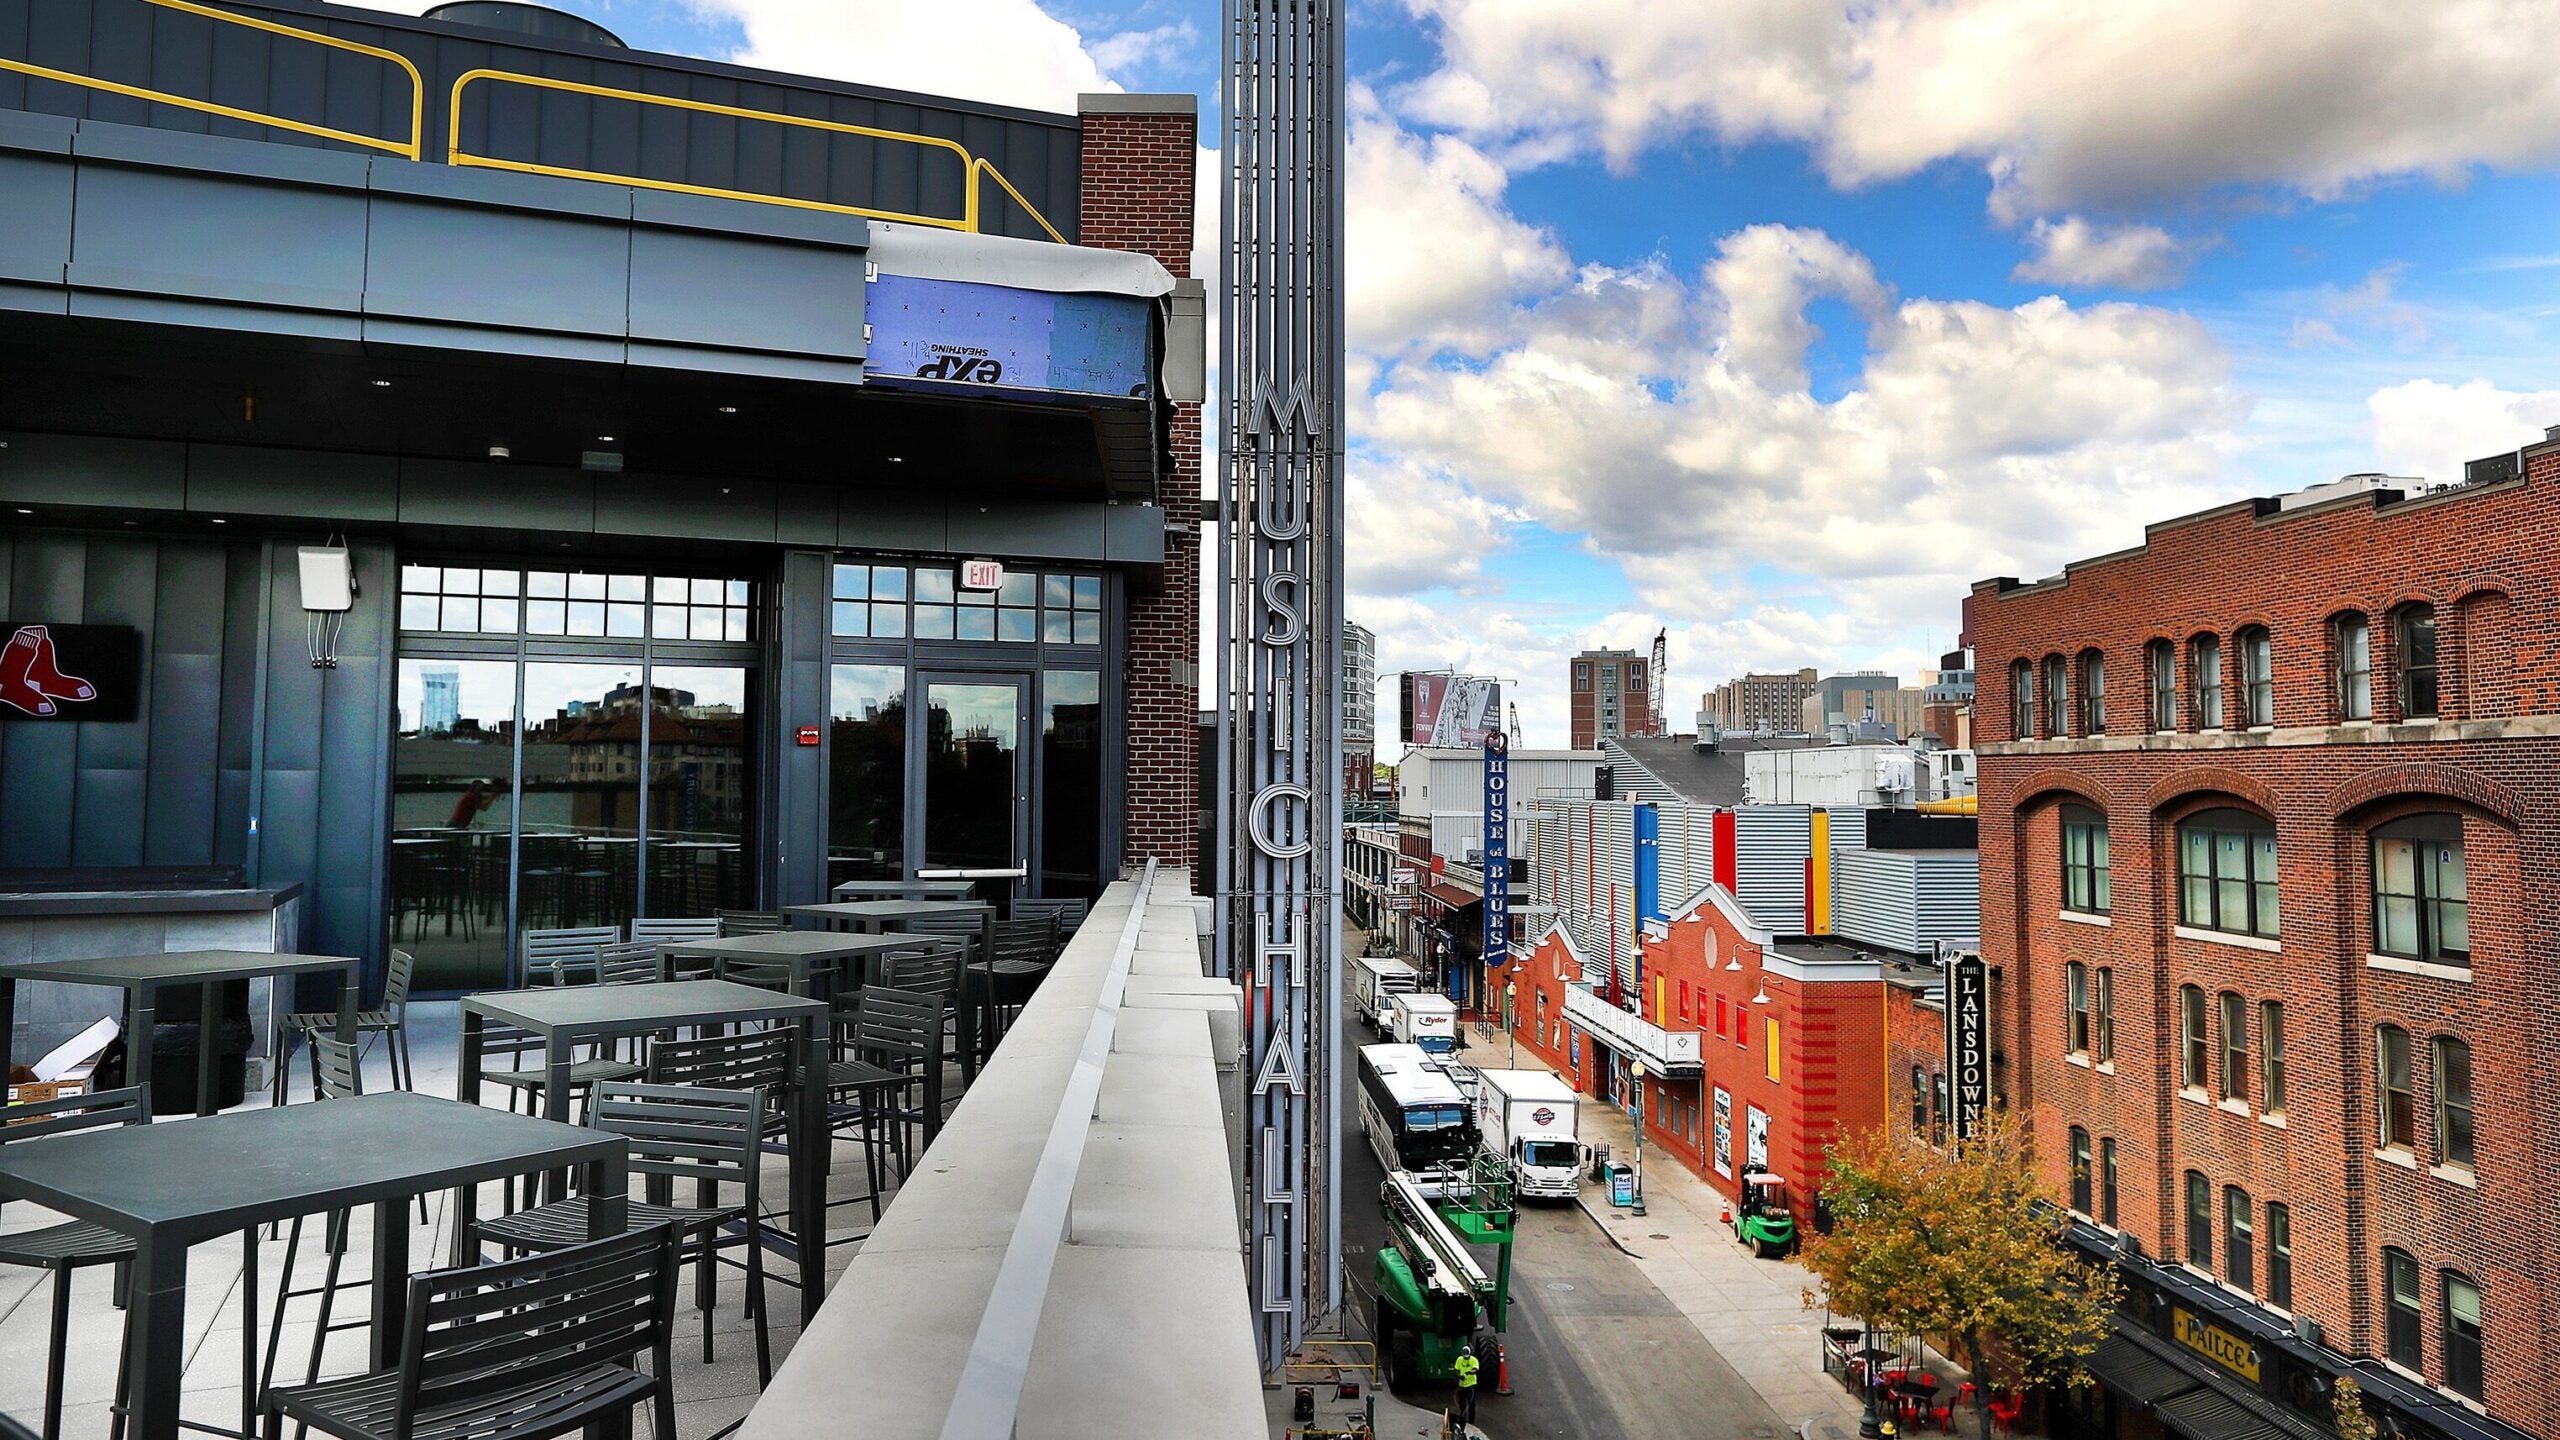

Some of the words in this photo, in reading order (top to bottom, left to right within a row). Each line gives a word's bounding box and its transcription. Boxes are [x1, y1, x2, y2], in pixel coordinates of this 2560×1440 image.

[931, 344, 989, 357] SHEATHING
[970, 564, 997, 586] EXIT
[1247, 369, 1320, 858] MUSIC
[1489, 760, 1504, 839] HOUSE
[1489, 864, 1504, 945] BLUES
[1961, 967, 1979, 975] THE
[1425, 1016, 1447, 1024] Ryder
[1962, 978, 1980, 1138] LANSDOWNE
[1252, 912, 1305, 1312] HALL
